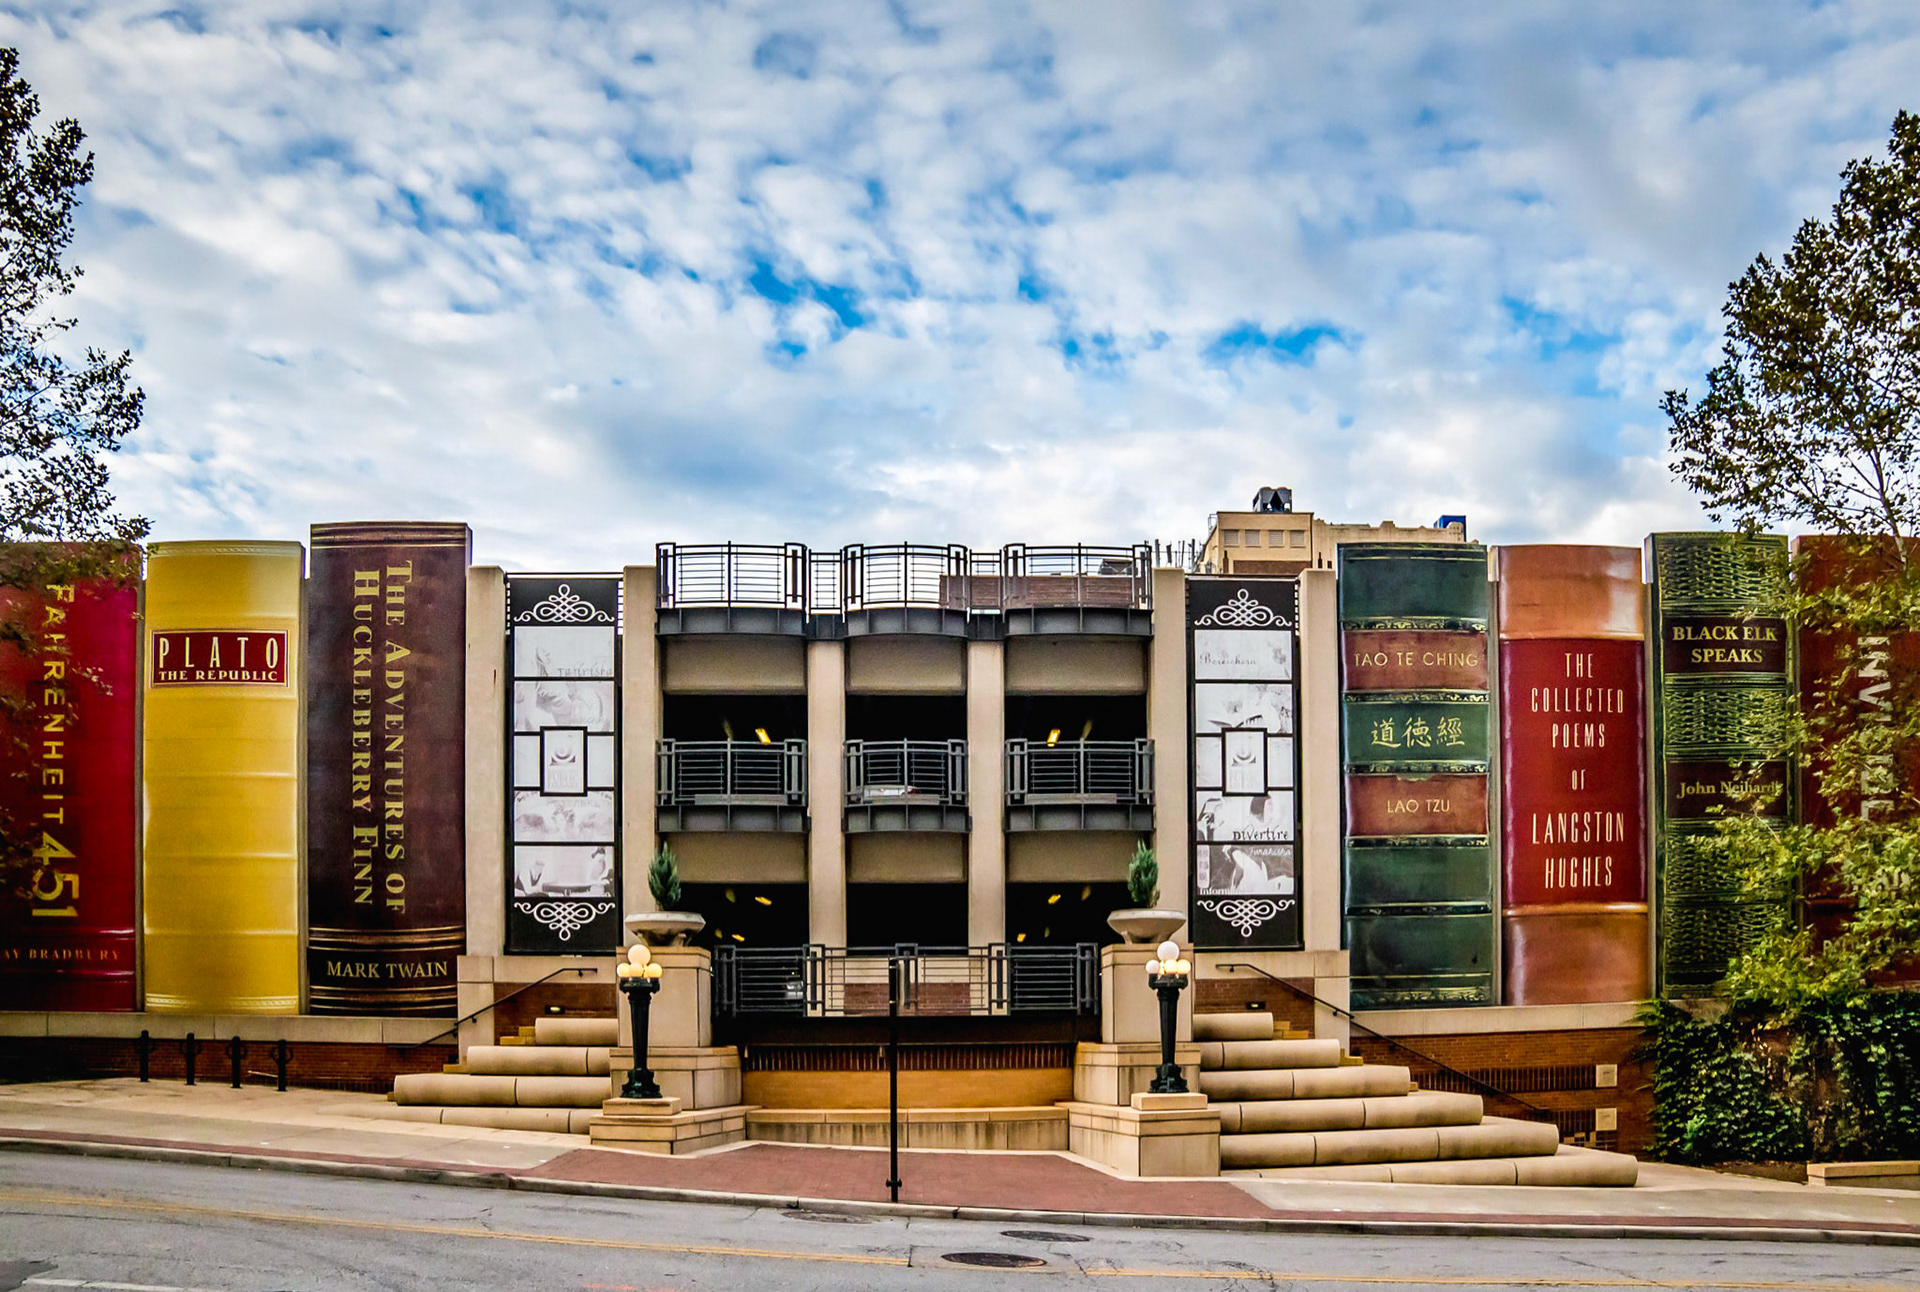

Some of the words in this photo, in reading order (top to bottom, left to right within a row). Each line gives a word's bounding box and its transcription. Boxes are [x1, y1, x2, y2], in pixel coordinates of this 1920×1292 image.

[386, 560, 412, 626] THE
[1672, 625, 1739, 641] BLACK
[1743, 626, 1778, 642] ELK
[159, 636, 279, 669] PLATO
[1354, 652, 1388, 668] TAO
[1397, 651, 1414, 666] TE
[1422, 652, 1479, 668] CHING
[1564, 652, 1594, 678] THE
[1691, 648, 1763, 663] SPEAKS
[159, 670, 188, 681] THE
[195, 670, 278, 681] REPUBLIC
[42, 584, 75, 825] FAHRENHEIT
[352, 570, 380, 813] HUCKLEBERRY
[1531, 687, 1624, 713] COLLECTED
[1552, 723, 1605, 748] POEMS
[384, 640, 411, 860] ADVENTURES
[1571, 769, 1586, 790] OF
[1676, 781, 1717, 799] John
[1720, 780, 1782, 796] Neihard
[1387, 799, 1419, 813] LAO
[1426, 798, 1450, 813] TZU
[1532, 811, 1625, 845] LANGSTON
[32, 831, 80, 917] 451
[353, 825, 379, 905] FINN
[1545, 856, 1613, 889] HUGHES
[385, 872, 406, 914] OF
[29, 948, 119, 960] BRADBURY
[326, 960, 381, 979] MARK
[386, 960, 448, 979] TWAIN
